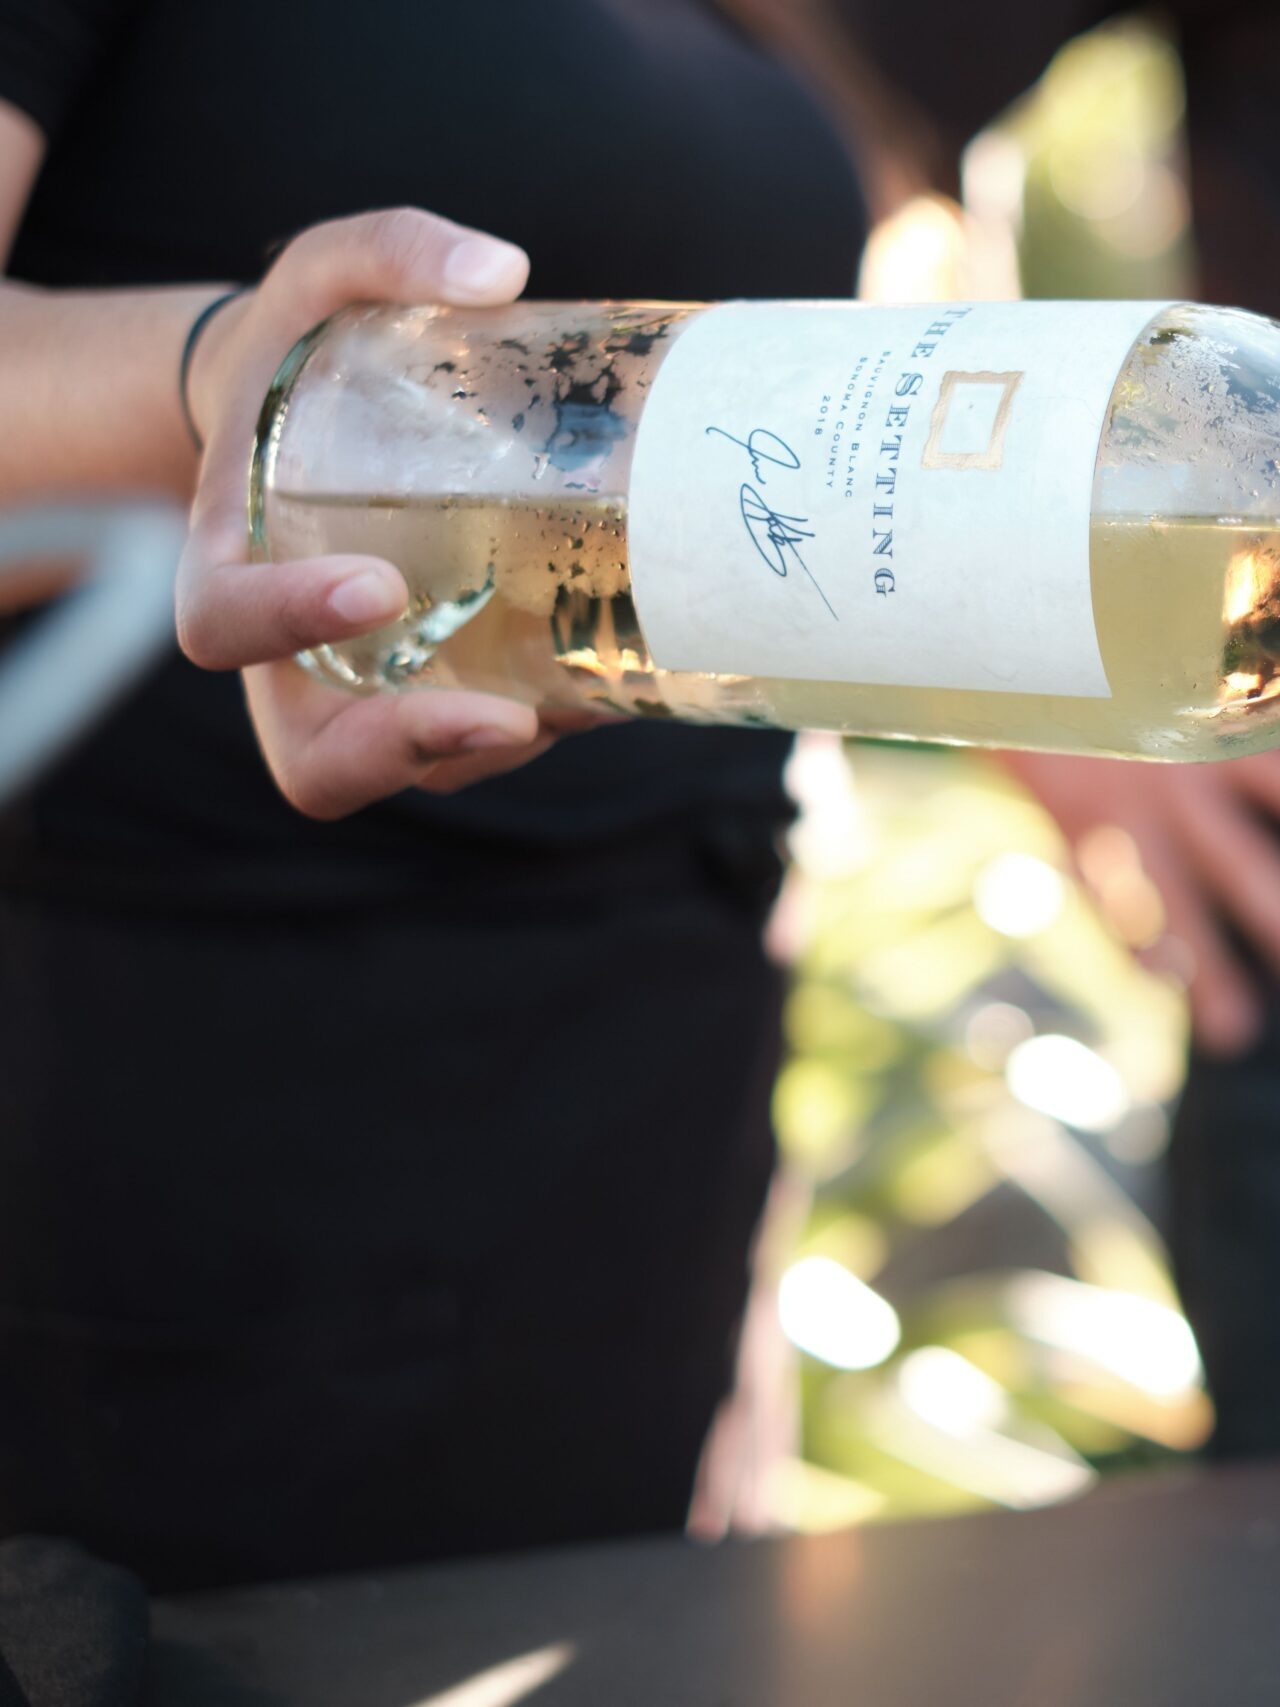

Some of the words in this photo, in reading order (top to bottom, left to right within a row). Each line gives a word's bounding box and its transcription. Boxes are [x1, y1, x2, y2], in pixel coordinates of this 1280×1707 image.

[911, 307, 973, 358] THE
[839, 357, 868, 412] SONOMA
[854, 350, 891, 431] SAUVIGNON
[814, 395, 831, 436] 2018
[826, 421, 844, 488] COUNTY
[844, 442, 860, 498] BLANC
[872, 372, 924, 598] SETTING
